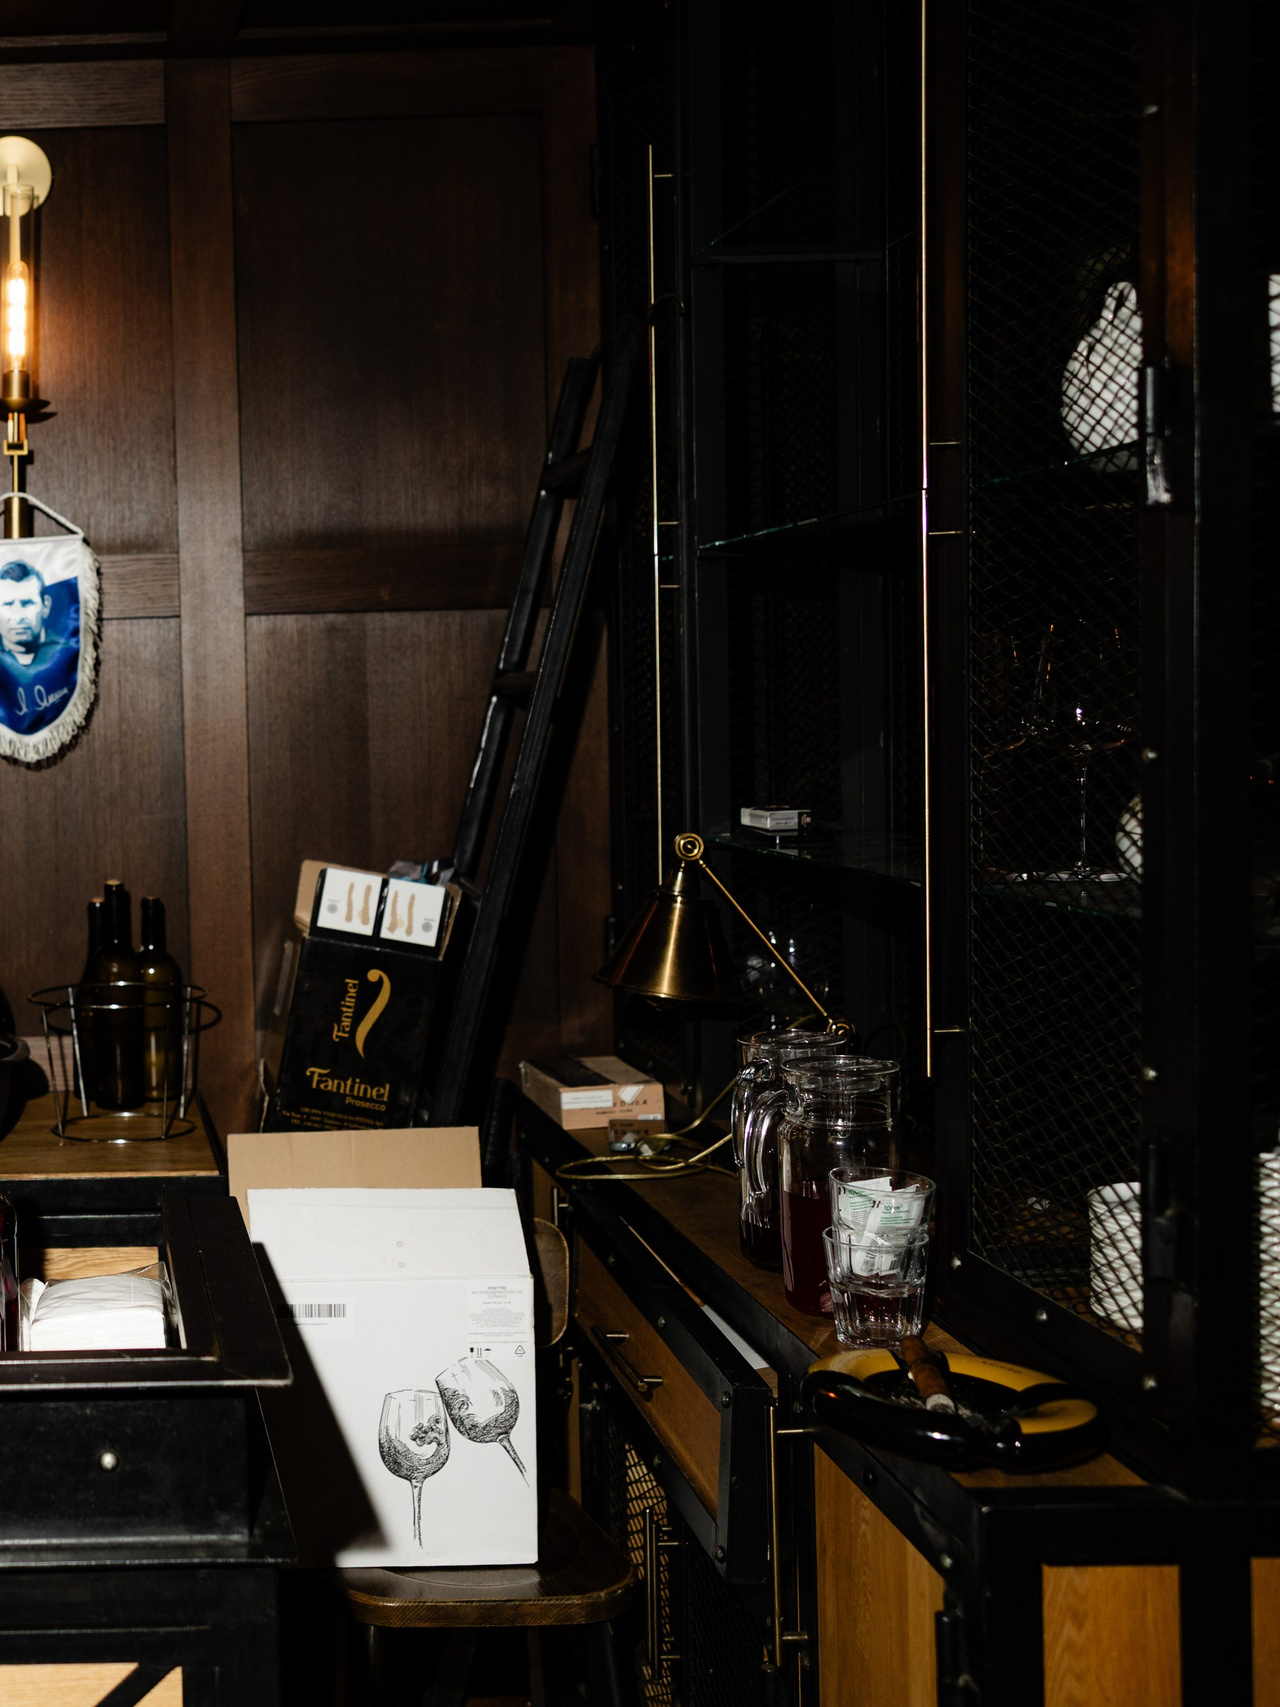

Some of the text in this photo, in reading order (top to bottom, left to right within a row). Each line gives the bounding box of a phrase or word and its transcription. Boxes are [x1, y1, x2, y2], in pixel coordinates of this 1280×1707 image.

[332, 978, 360, 1042] Fantinel
[305, 1066, 391, 1103] Fantinel
[345, 1096, 387, 1112] Prosecco
